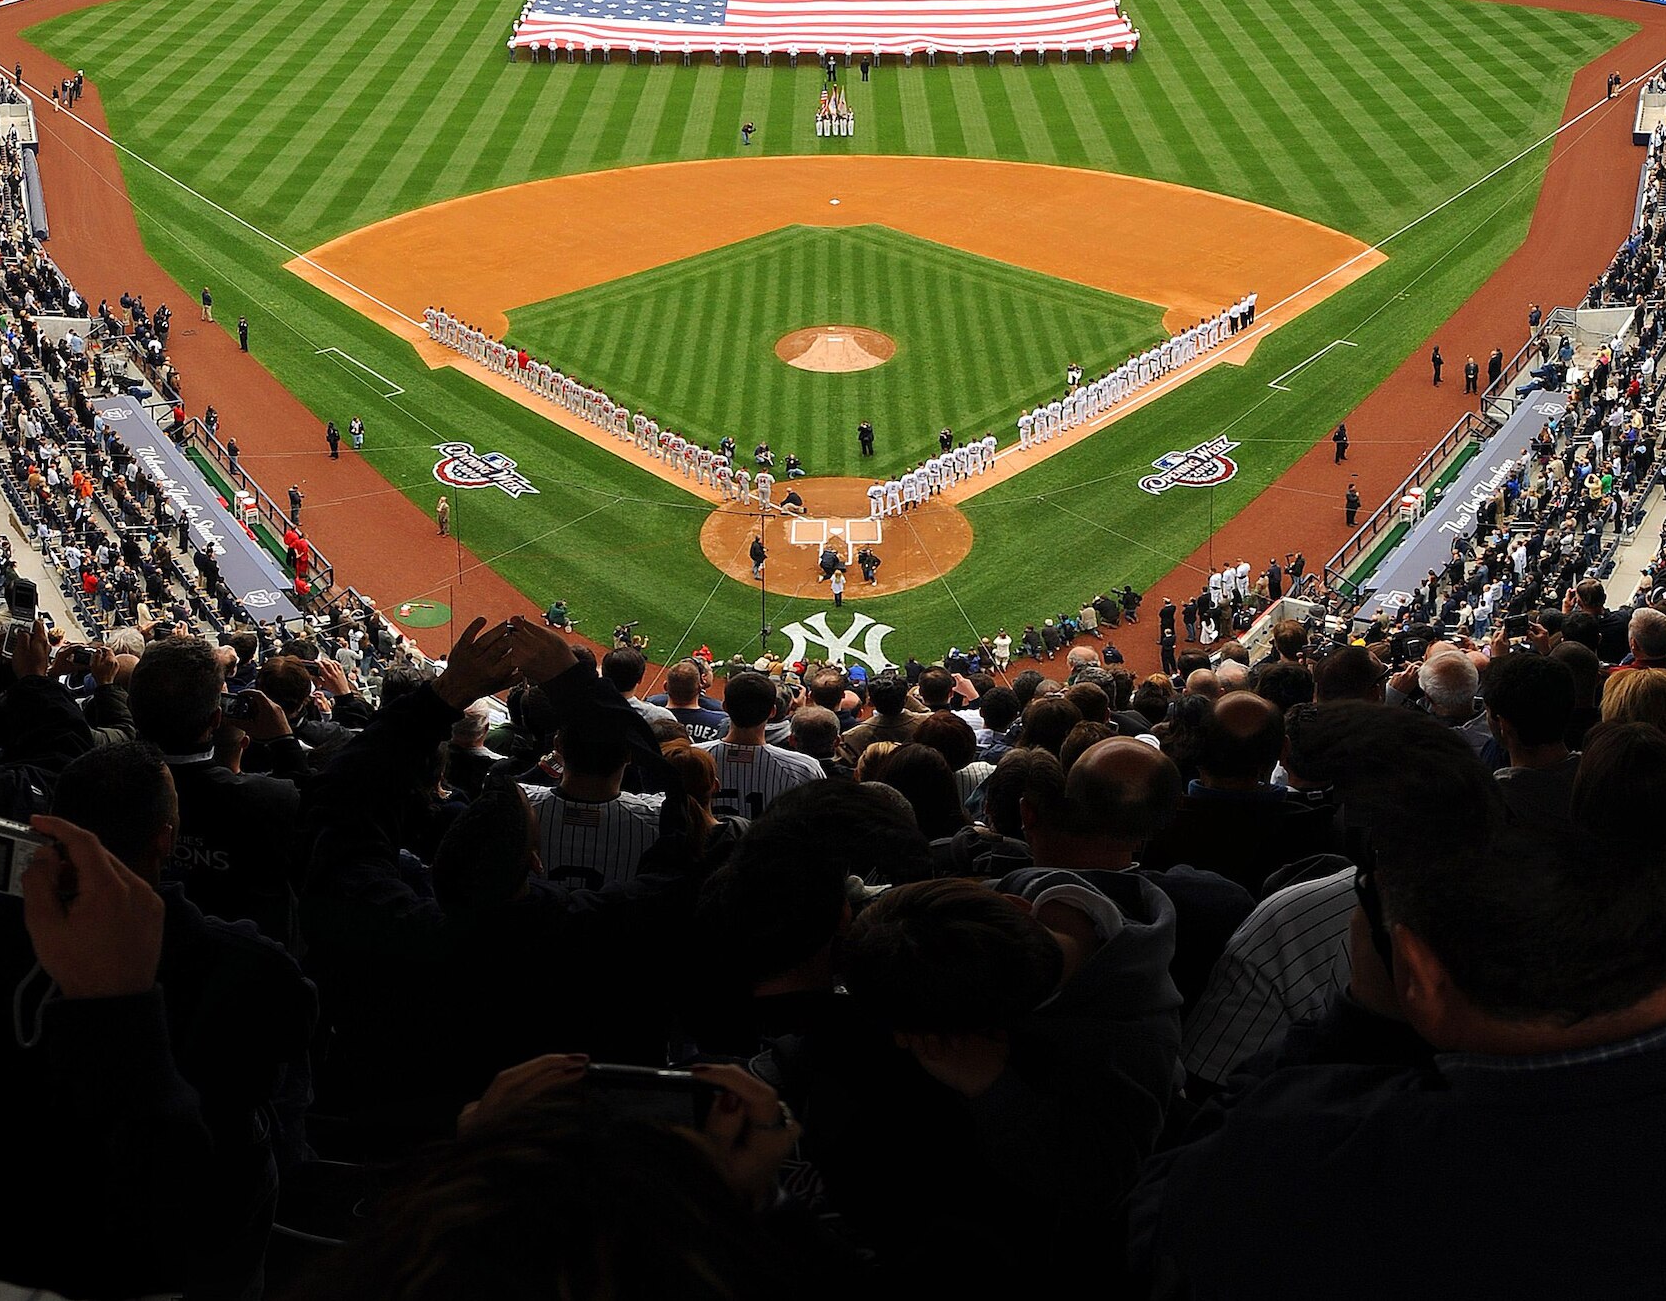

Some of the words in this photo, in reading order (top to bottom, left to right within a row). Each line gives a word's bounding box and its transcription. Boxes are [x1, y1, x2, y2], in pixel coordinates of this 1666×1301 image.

[1438, 509, 1471, 534] New
[1477, 458, 1516, 499] Yankees
[779, 611, 900, 675] NY
[685, 723, 718, 741] GUEZ
